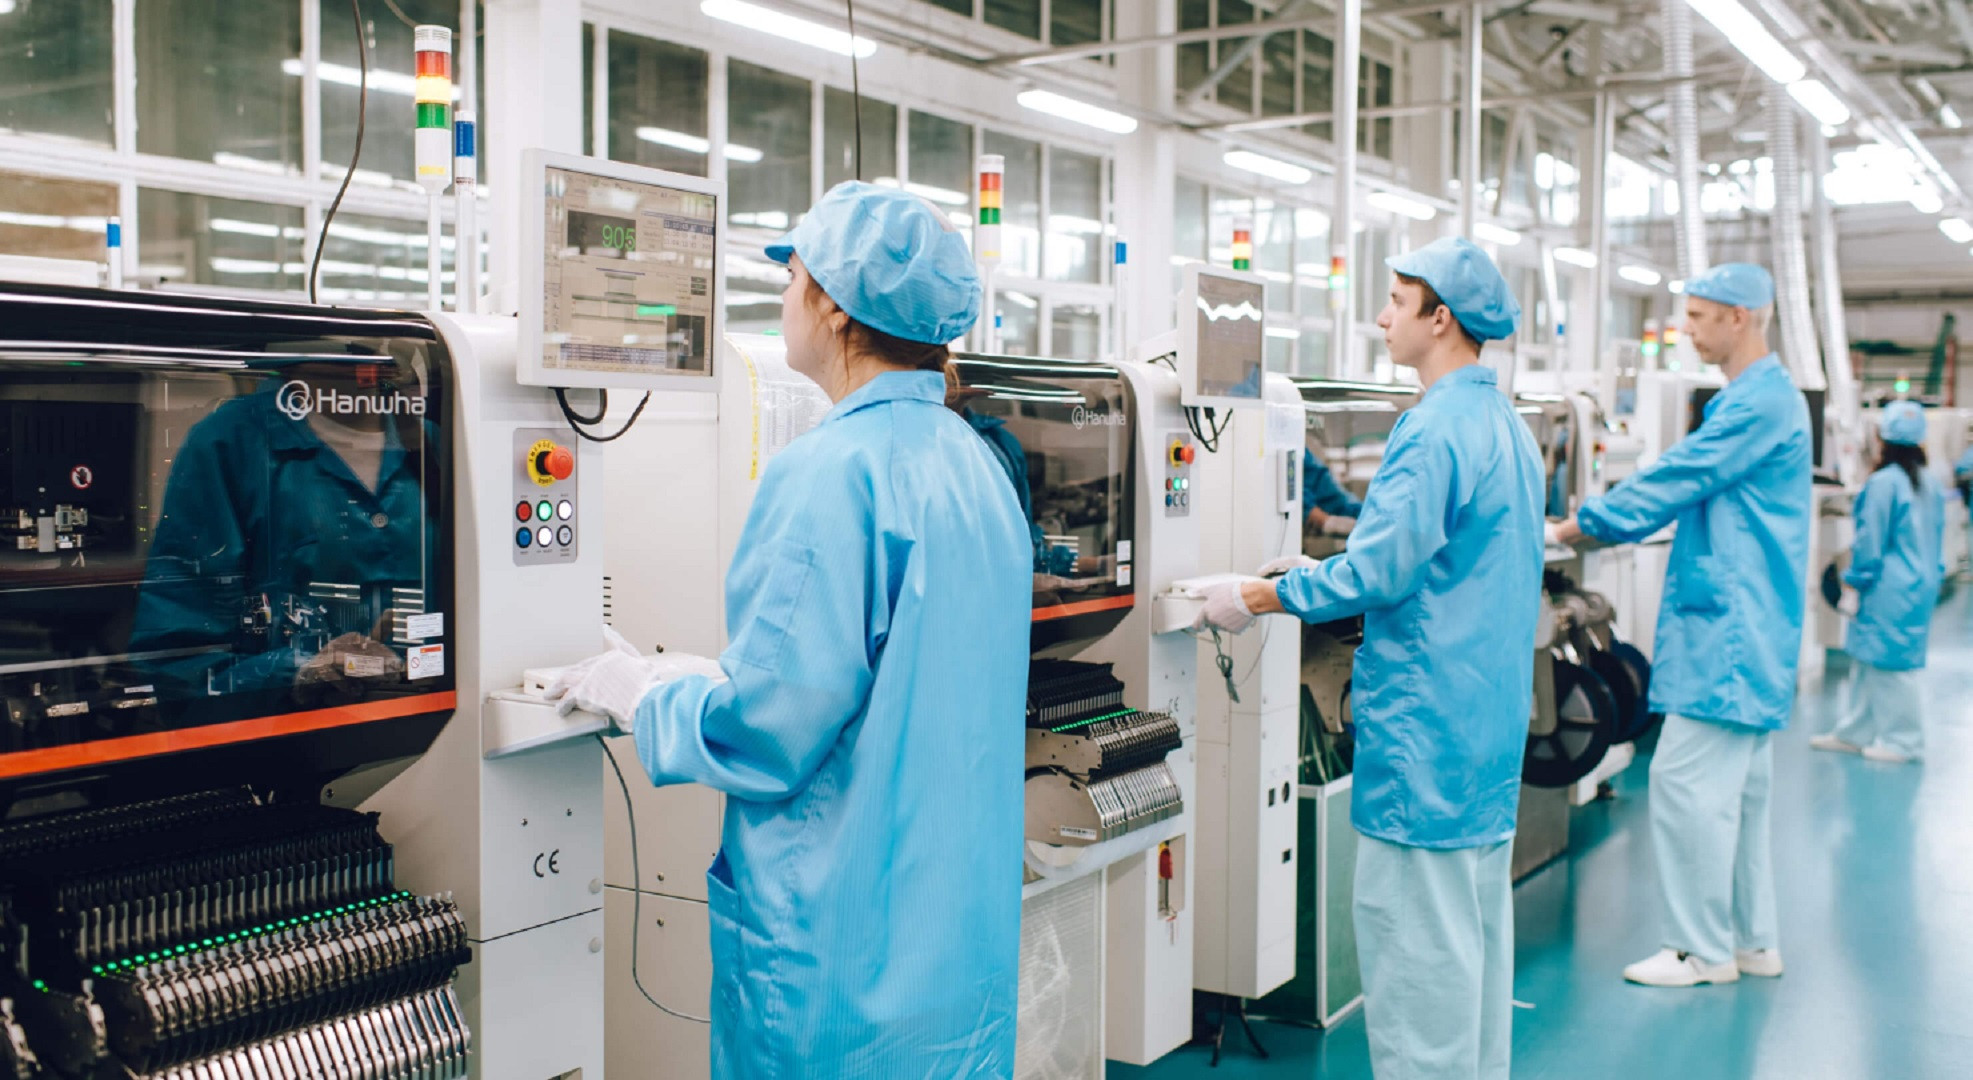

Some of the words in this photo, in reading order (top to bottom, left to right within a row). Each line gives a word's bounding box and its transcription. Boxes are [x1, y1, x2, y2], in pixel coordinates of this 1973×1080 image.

[602, 224, 636, 252] 905
[316, 388, 426, 415] Hanwha
[1086, 410, 1126, 426] Hanwha
[533, 848, 560, 878] CE
